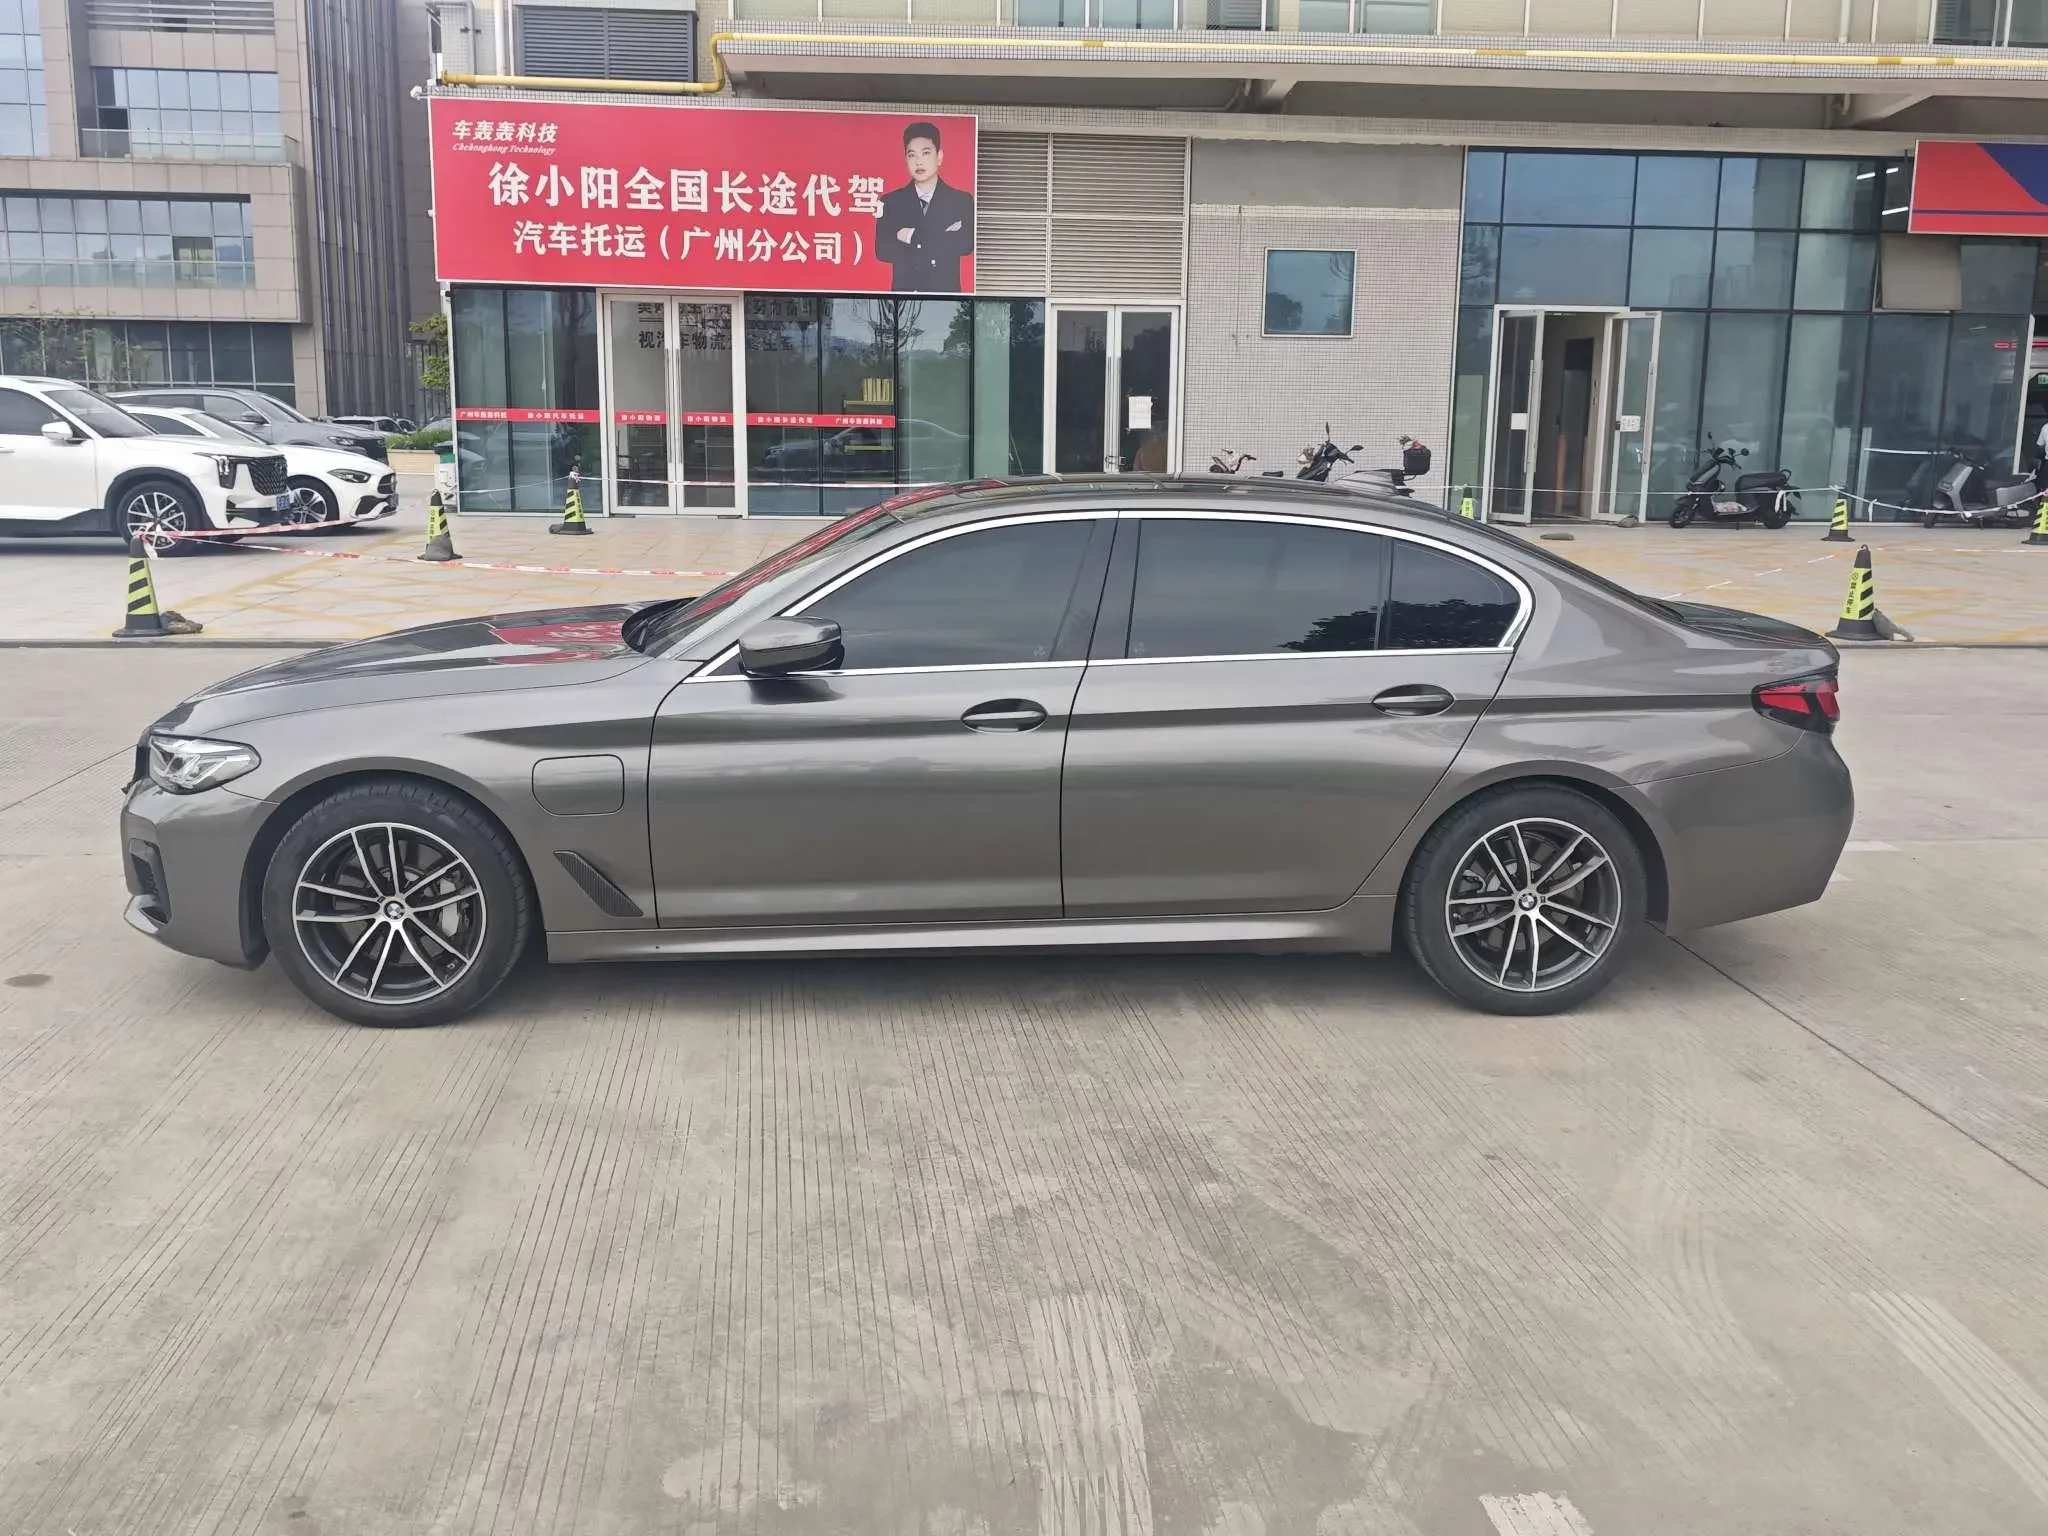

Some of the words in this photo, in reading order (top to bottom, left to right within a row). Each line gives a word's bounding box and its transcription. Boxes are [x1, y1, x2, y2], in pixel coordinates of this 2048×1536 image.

[451, 119, 559, 143] 车轰轰科技
[510, 145, 557, 156] Technology
[488, 161, 885, 218] 徐小阳全国长途代驾
[513, 220, 864, 266] 汽车托运（广州分公司）
